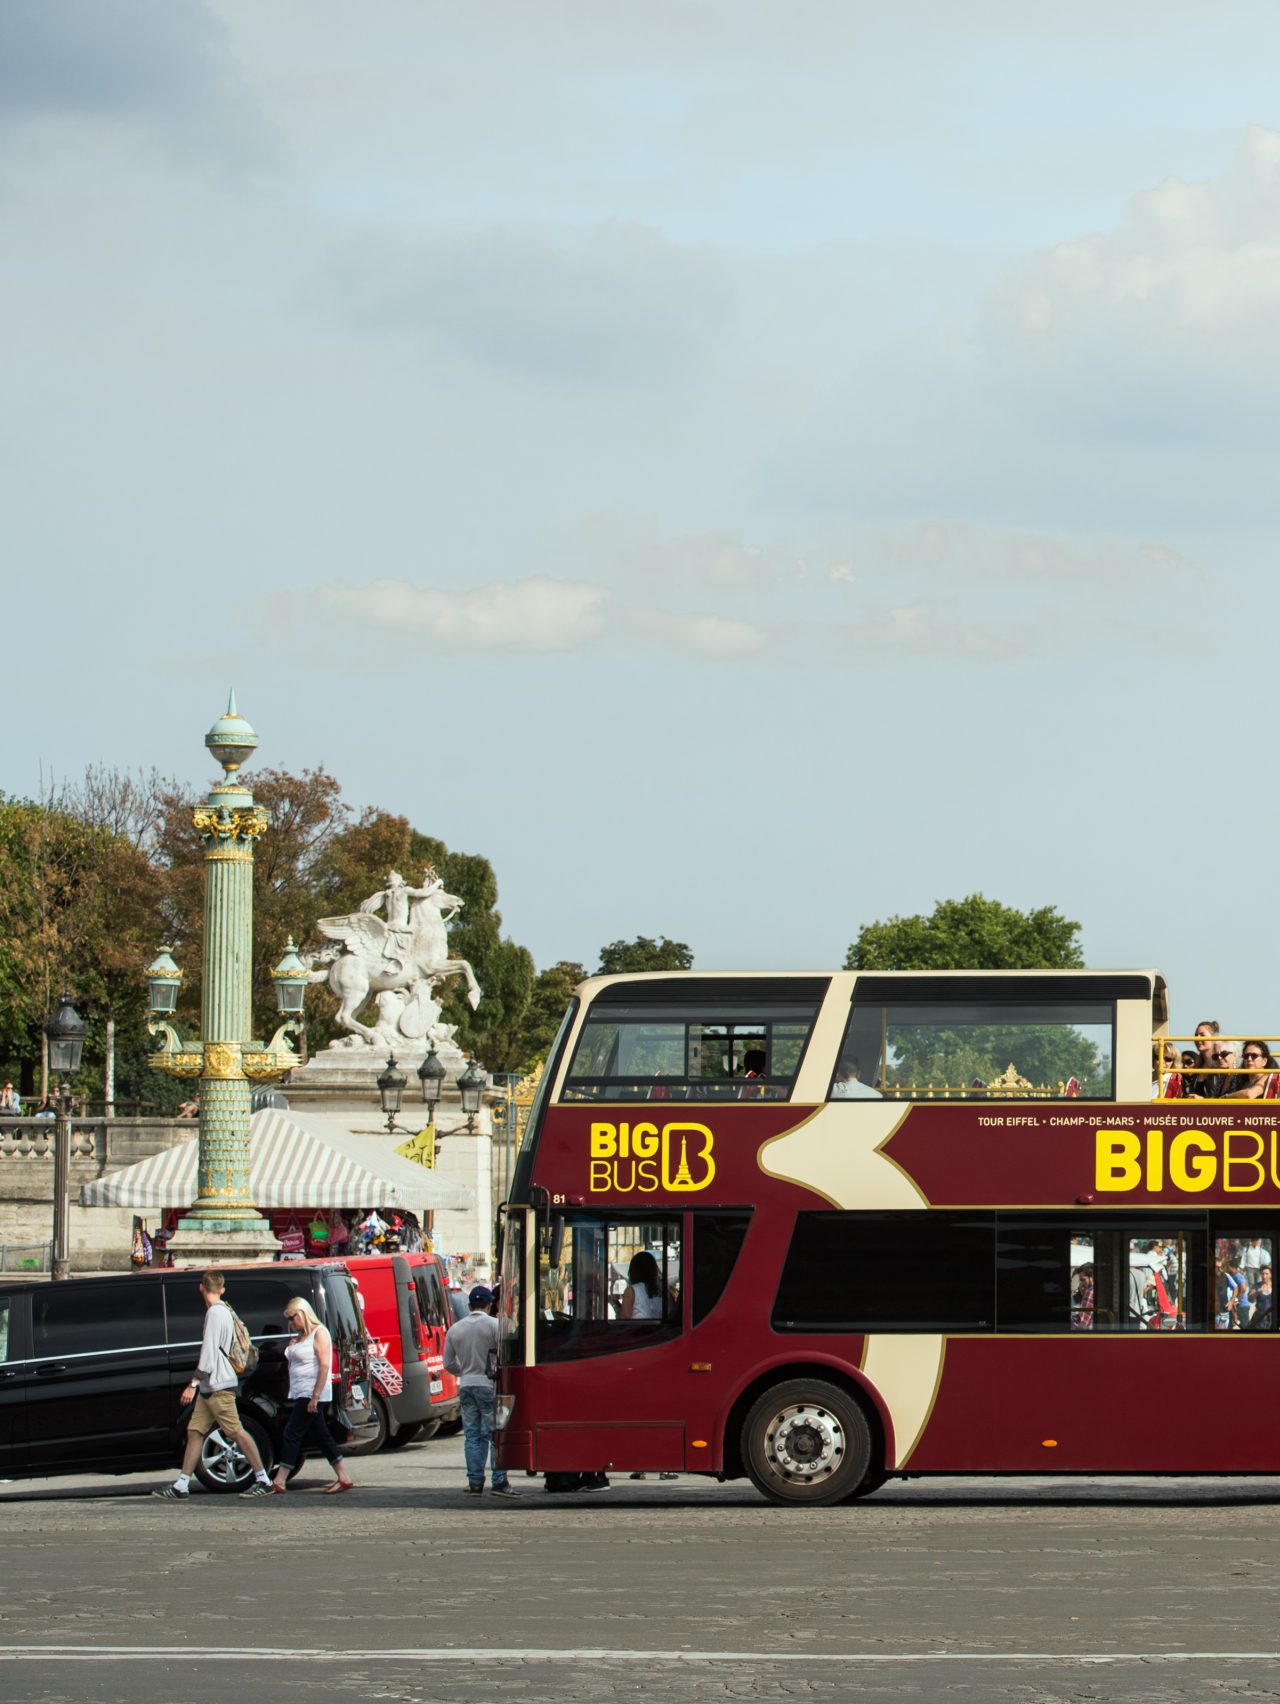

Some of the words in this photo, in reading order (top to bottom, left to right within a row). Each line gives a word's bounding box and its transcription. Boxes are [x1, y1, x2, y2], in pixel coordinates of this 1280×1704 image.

[978, 1117, 1003, 1126] TOUR
[1006, 1117, 1039, 1126] EIFFEL
[1050, 1117, 1134, 1126] CHAMP-DE-MARS
[1144, 1115, 1177, 1126] MUSÉE
[1180, 1117, 1193, 1126] DU
[1196, 1117, 1234, 1126] LOUVRE
[590, 1123, 659, 1158] BIG
[590, 1160, 659, 1192] BUS
[553, 1194, 566, 1204] 81
